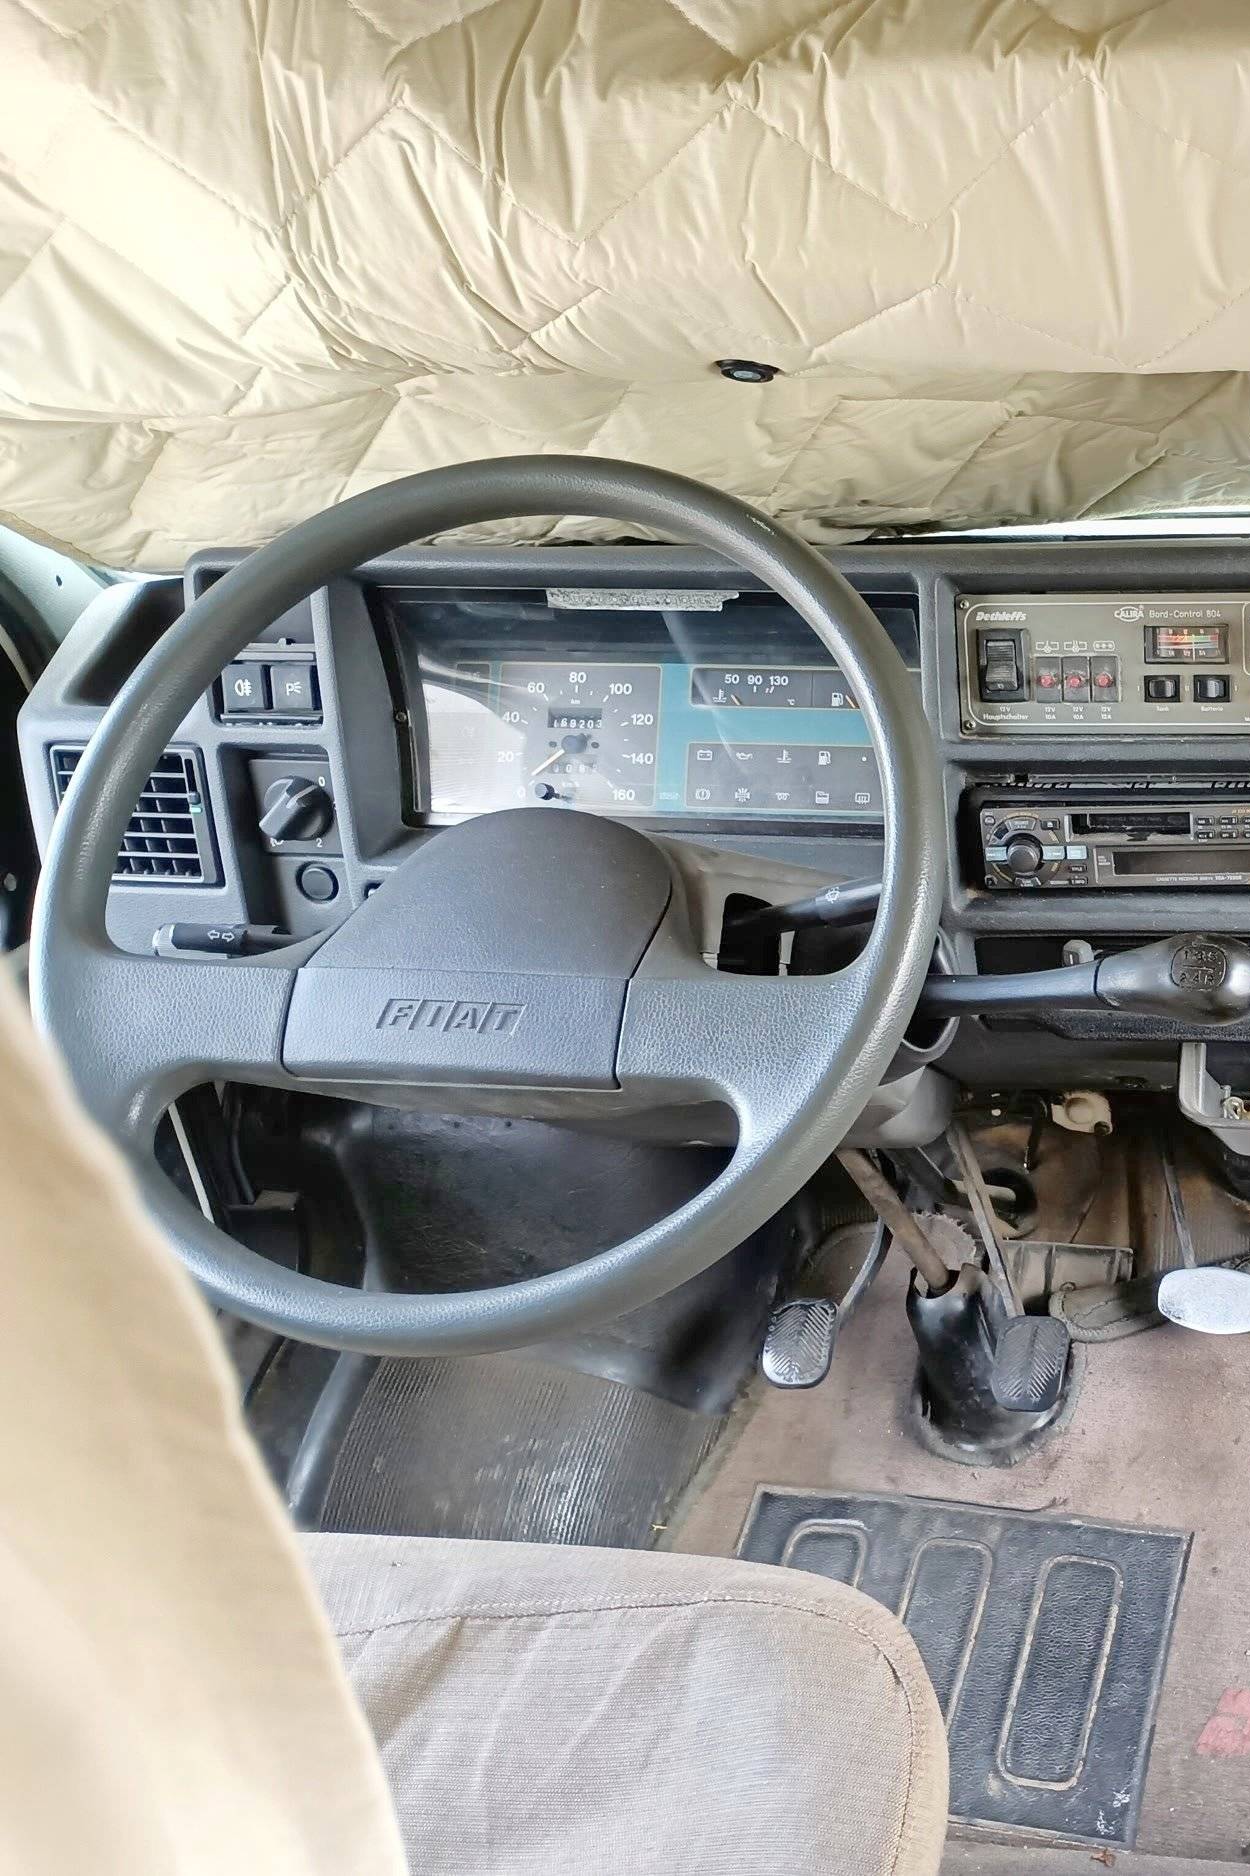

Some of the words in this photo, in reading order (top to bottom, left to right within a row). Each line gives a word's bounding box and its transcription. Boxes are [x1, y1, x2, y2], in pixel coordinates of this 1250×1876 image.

[975, 611, 1027, 621] Dethleffs
[1113, 609, 1145, 619] CALIRA
[1149, 609, 1203, 618] Bord-Control
[569, 672, 587, 683] 80
[724, 674, 740, 685] 50
[747, 675, 763, 685] 90
[769, 676, 789, 686] 130
[527, 682, 545, 694] 60
[609, 684, 633, 695] 100
[503, 711, 520, 723] 40
[631, 714, 654, 726] 120
[983, 713, 1029, 722] Hauptschalter
[497, 751, 515, 763] 20
[630, 754, 654, 765] 140
[516, 786, 526, 799] 0
[612, 789, 636, 801] 160
[384, 1001, 521, 1033] FIAT
